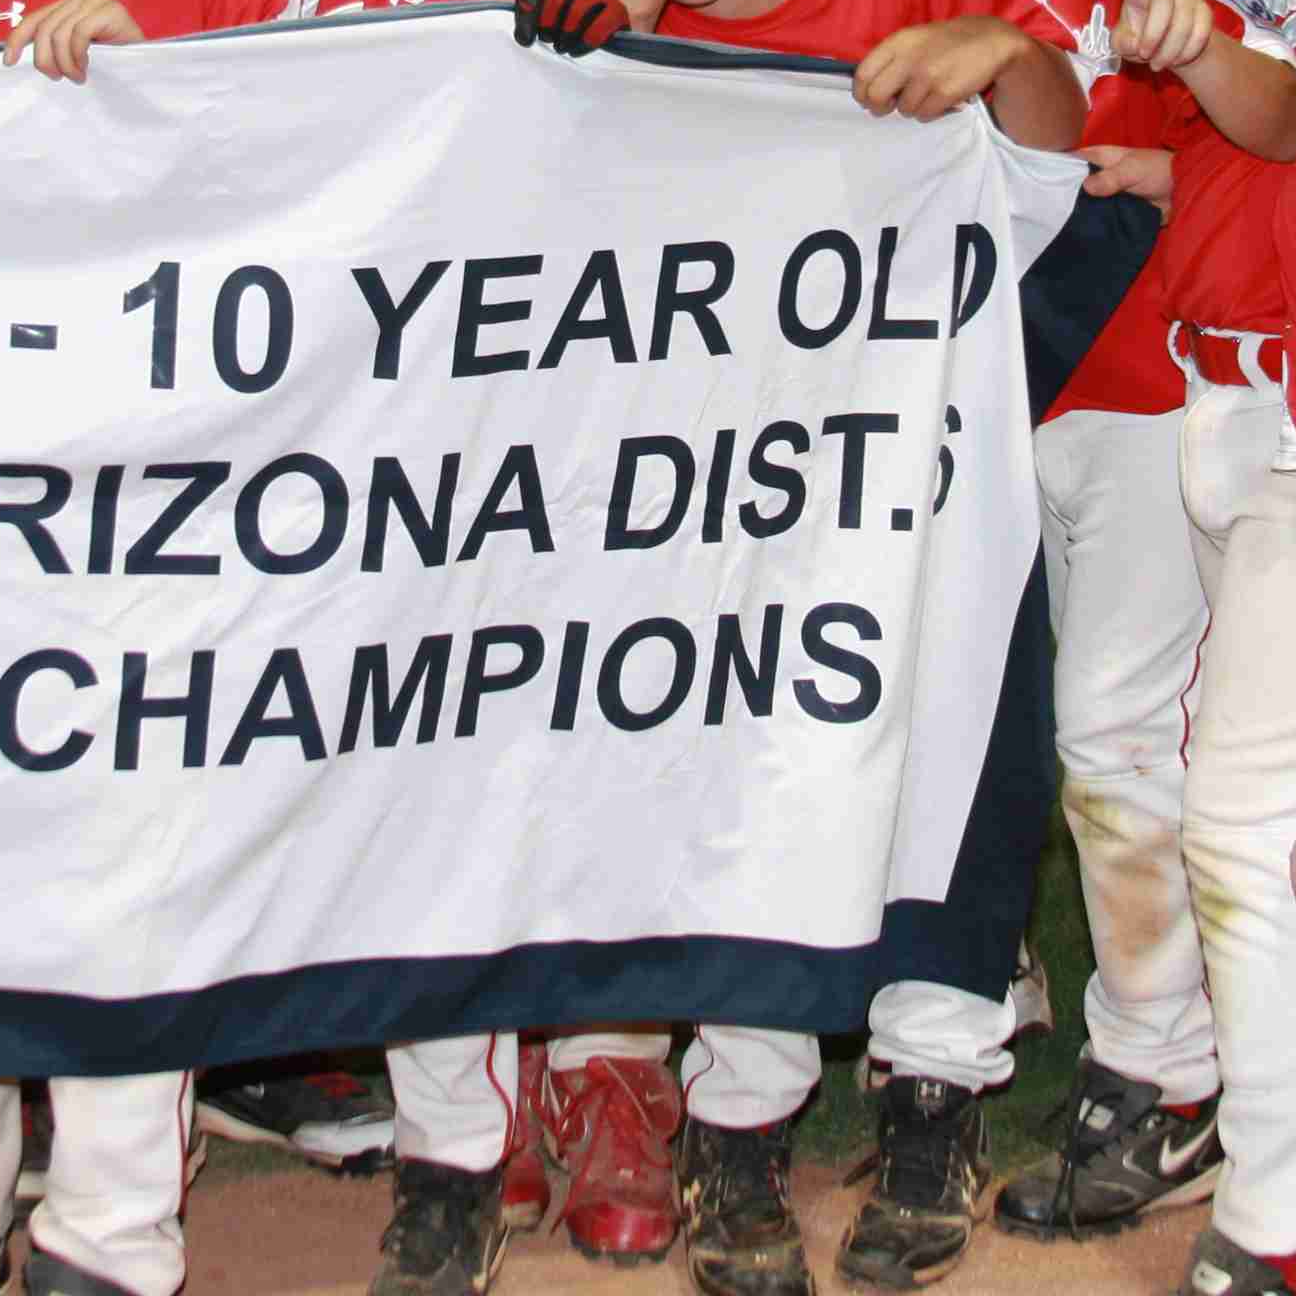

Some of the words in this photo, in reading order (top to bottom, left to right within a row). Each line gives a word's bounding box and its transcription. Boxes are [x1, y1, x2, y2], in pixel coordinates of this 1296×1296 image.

[122, 260, 294, 394] 10
[351, 239, 736, 380] YEAR
[777, 221, 998, 350] OLD
